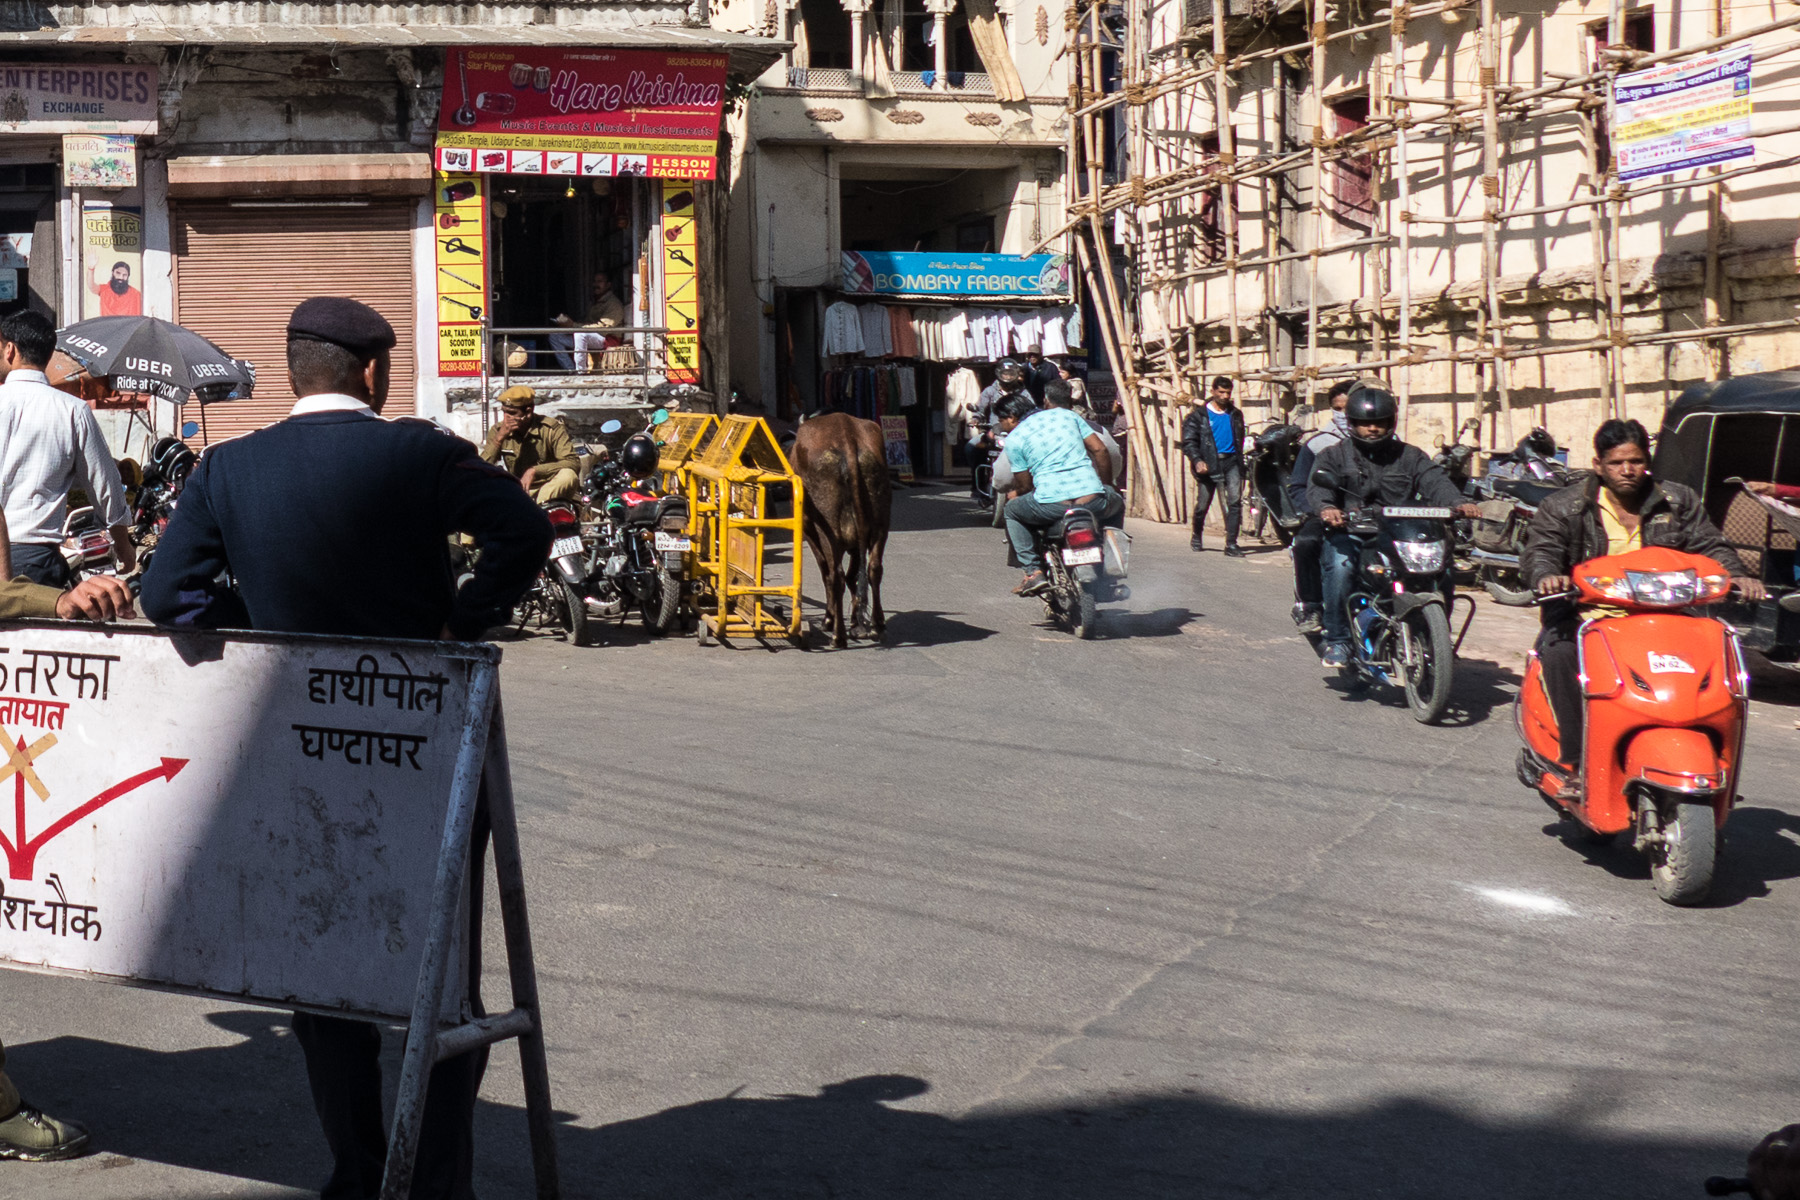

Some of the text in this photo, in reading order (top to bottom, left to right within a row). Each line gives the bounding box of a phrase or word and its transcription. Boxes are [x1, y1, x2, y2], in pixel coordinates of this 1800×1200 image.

[467, 51, 487, 62] Gopal
[466, 62, 505, 75] Sitar Player
[550, 69, 720, 114] Hare Krishna
[42, 101, 105, 114] EXCHANGE
[500, 119, 713, 137] Music Events & Musical Instruments
[443, 134, 465, 146] Jagdish
[467, 135, 488, 147] Temple,
[490, 136, 513, 149] Udaipur
[514, 137, 533, 147] E-mail
[652, 158, 711, 168] LESSON
[652, 168, 710, 178] FACILITY
[876, 273, 1040, 291] BOMBAY FABRICS
[440, 329, 453, 338] CAR,
[454, 329, 469, 338] TAXI,
[65, 333, 109, 358] UBER
[449, 339, 476, 347] SCOOTOR
[450, 349, 475, 357] ON RENT
[125, 356, 173, 377] UBER
[191, 363, 228, 378] UBER
[116, 376, 137, 389] Ride
[138, 379, 149, 390] at
[10, 648, 121, 701] तरफा
[292, 723, 429, 770] घण्टाघर
